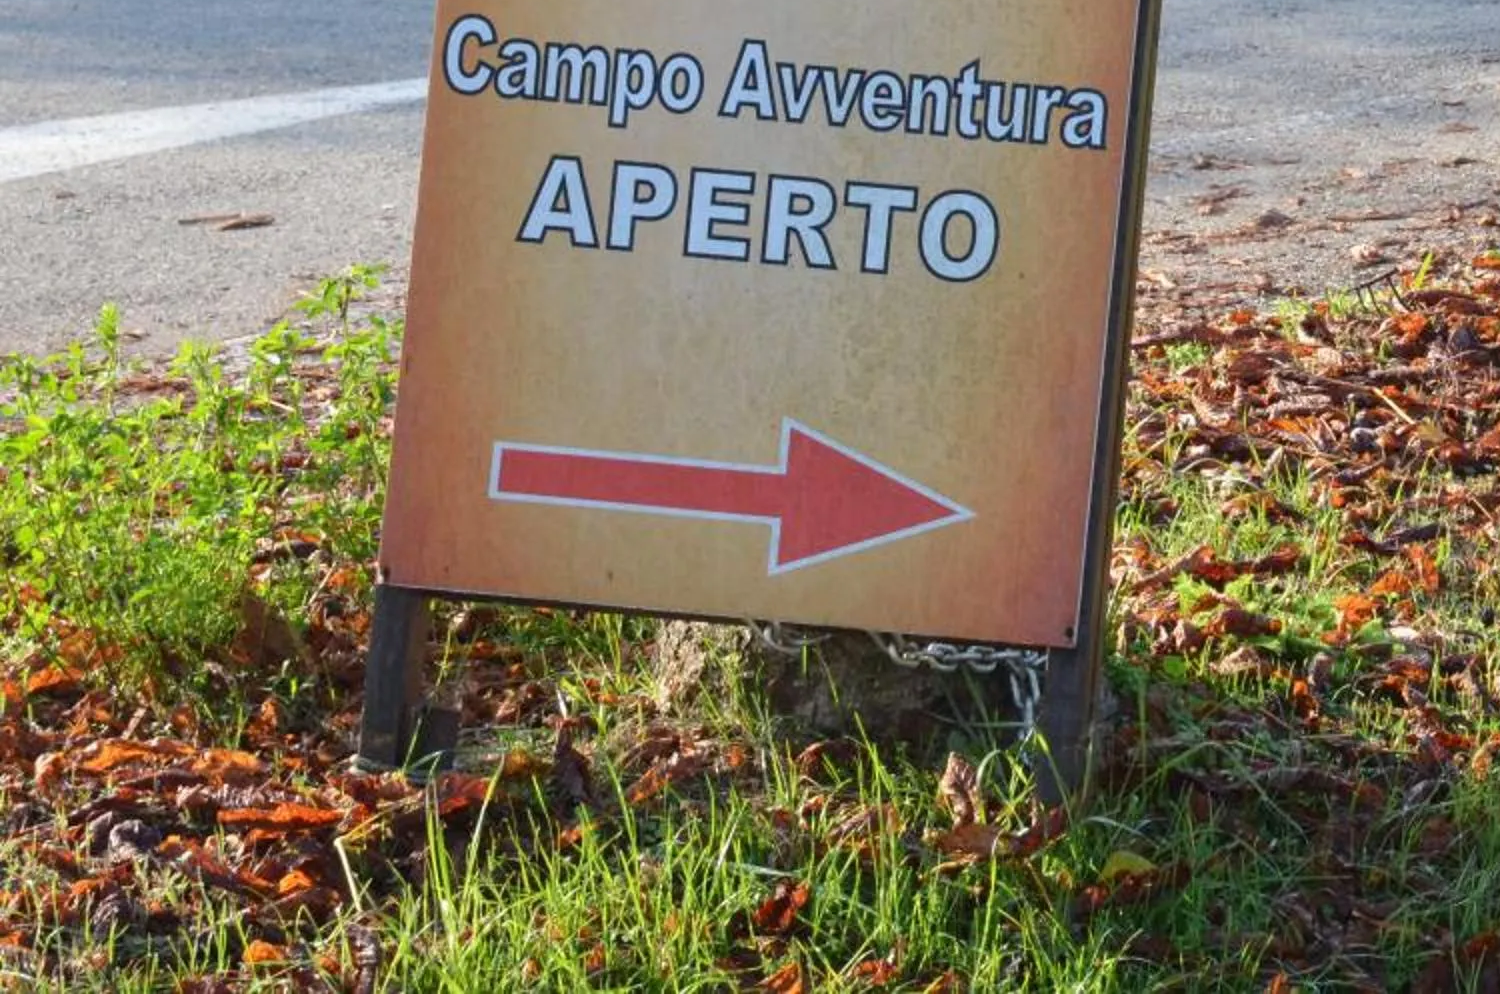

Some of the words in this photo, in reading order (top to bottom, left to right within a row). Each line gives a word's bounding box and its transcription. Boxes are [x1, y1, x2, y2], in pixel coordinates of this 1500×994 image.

[442, 14, 702, 128] Campo
[718, 38, 1109, 149] Avventura
[515, 154, 1000, 283] APERTO
